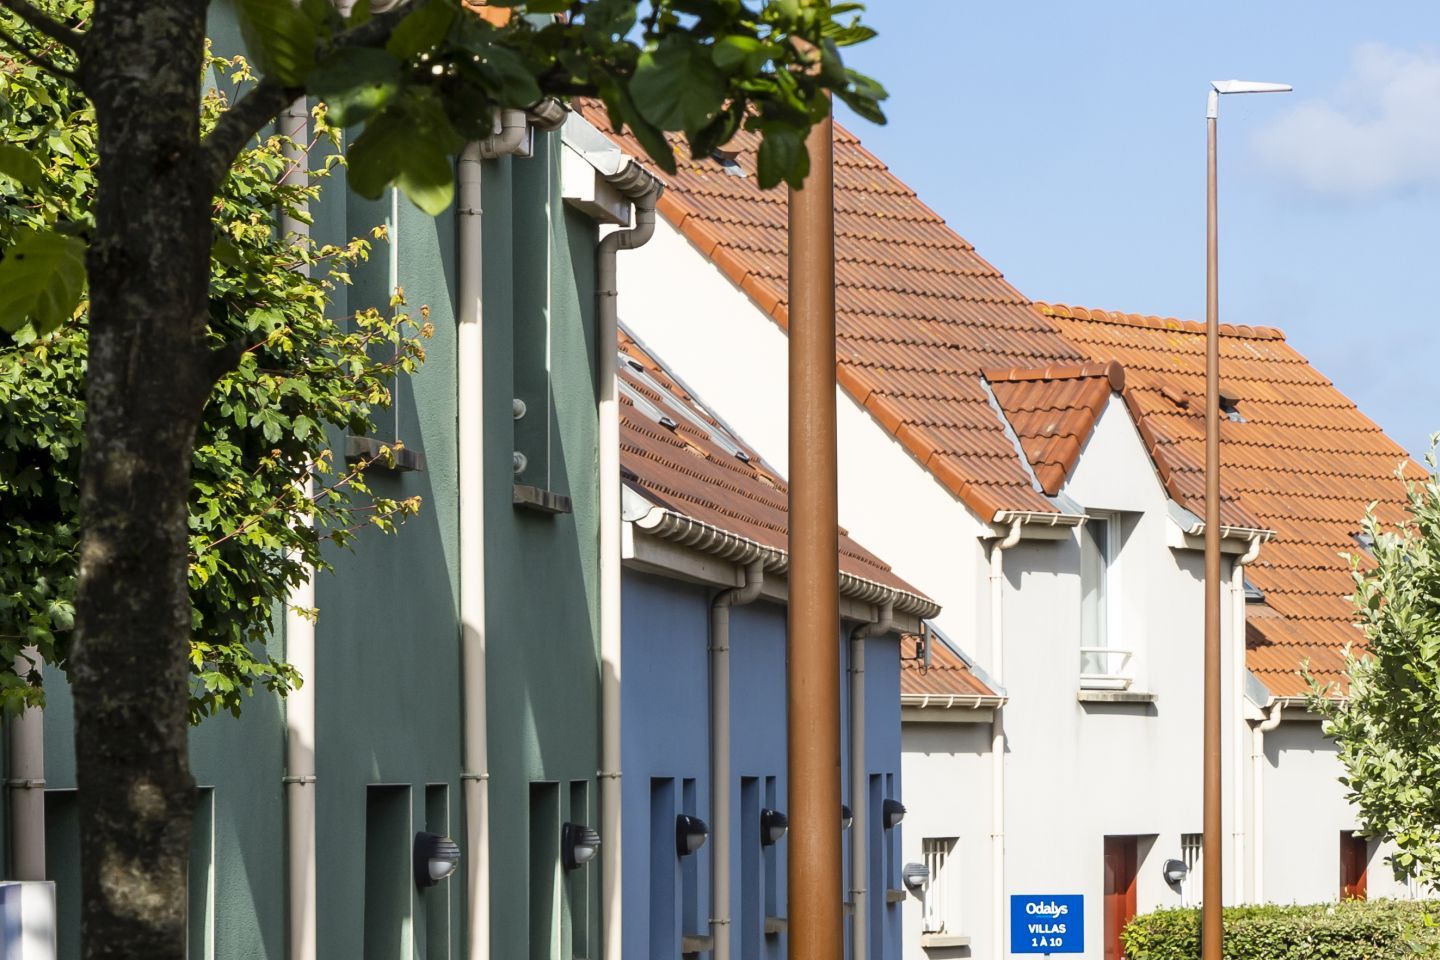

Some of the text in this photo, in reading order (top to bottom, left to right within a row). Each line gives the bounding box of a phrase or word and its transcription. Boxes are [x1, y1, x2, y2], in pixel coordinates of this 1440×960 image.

[1026, 901, 1068, 918] Odalys
[1028, 923, 1066, 933] VILLAS
[1032, 938, 1038, 946] 1
[1050, 938, 1062, 946] 10
